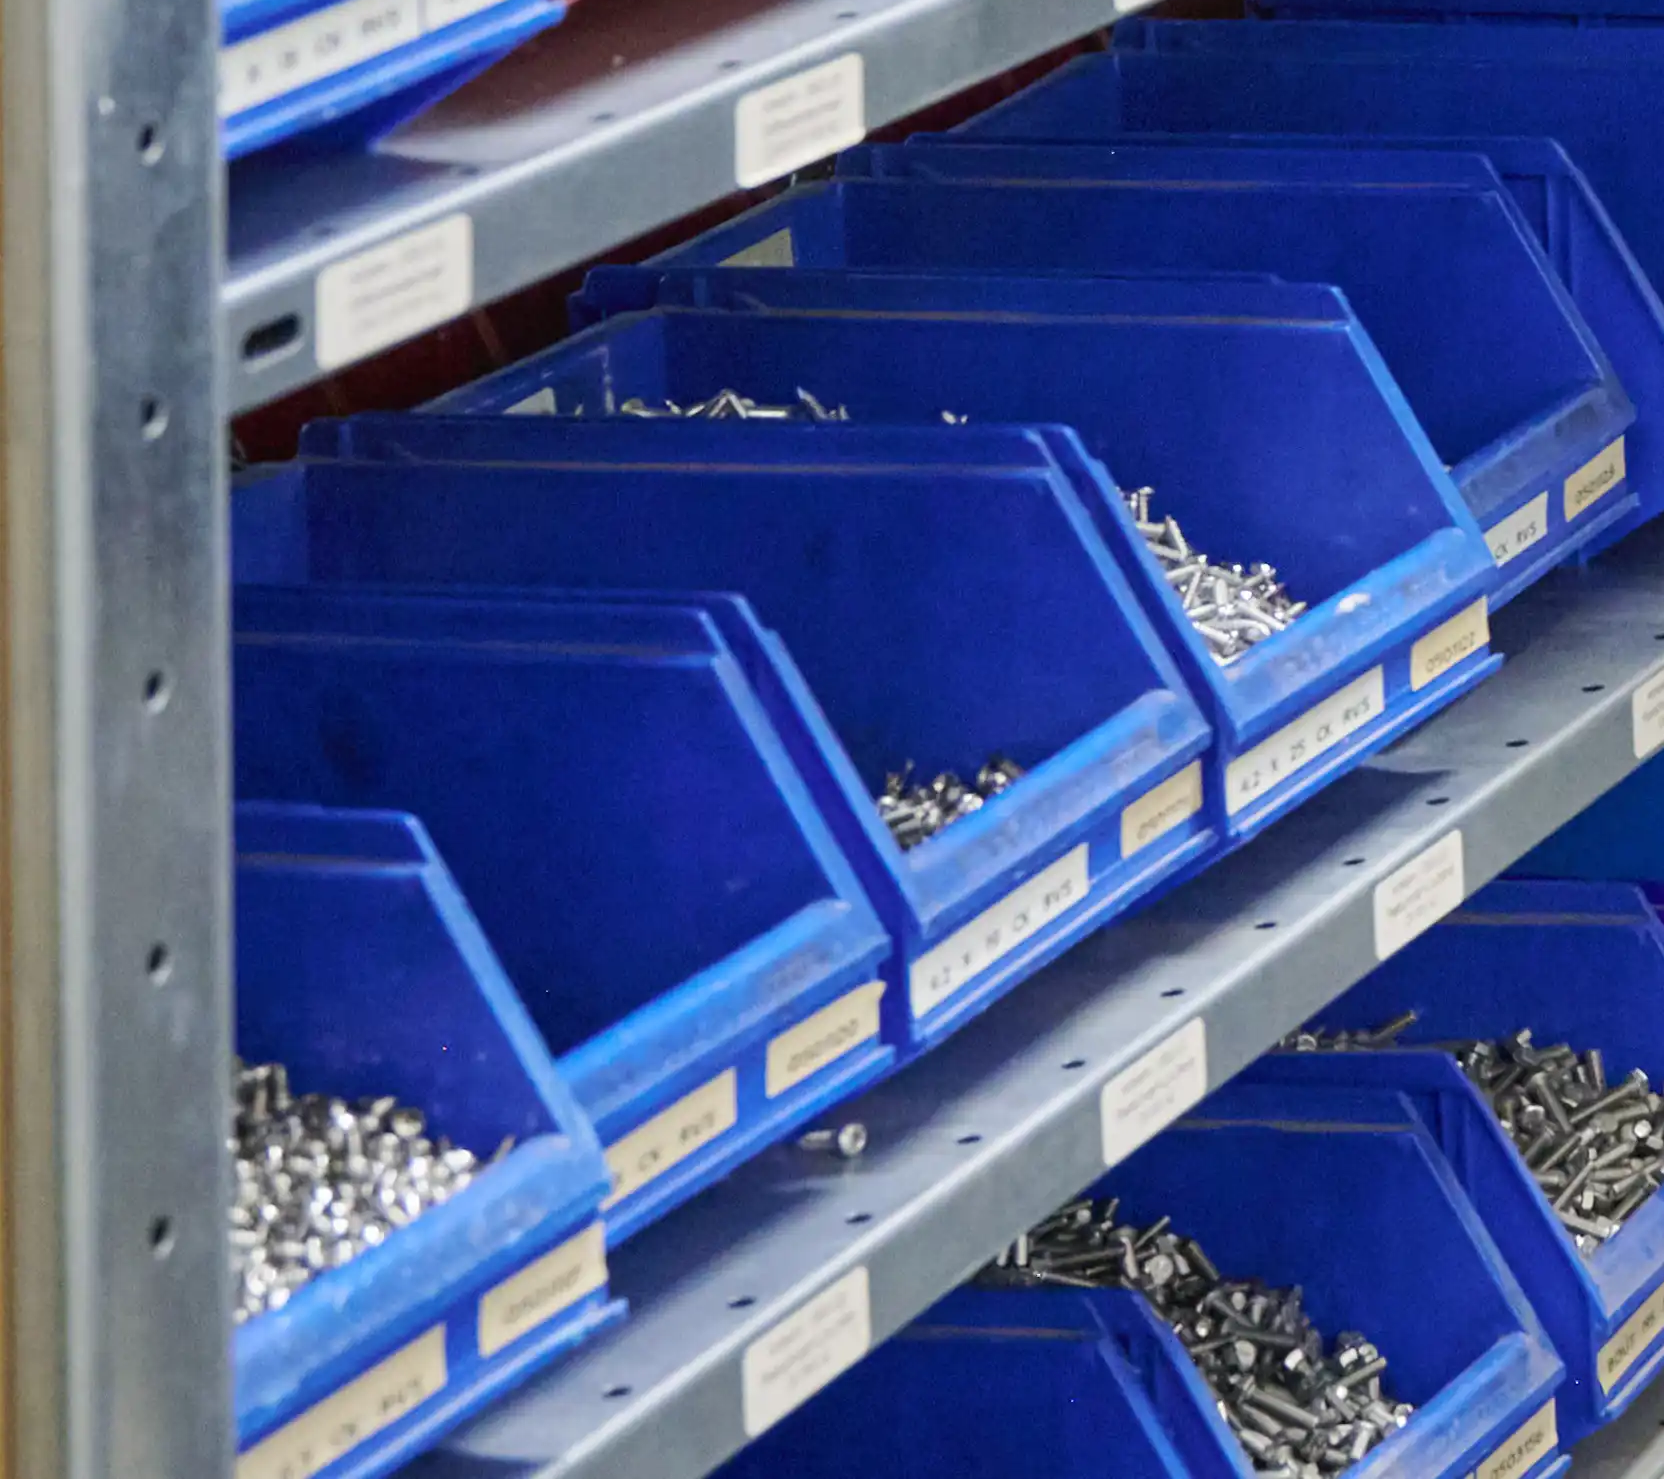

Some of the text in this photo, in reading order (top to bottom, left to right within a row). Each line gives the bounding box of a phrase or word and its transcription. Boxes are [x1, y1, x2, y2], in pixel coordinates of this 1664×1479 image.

[1516, 520, 1537, 545] RVS
[1342, 695, 1372, 724] RVS
[1042, 877, 1074, 908] RVS
